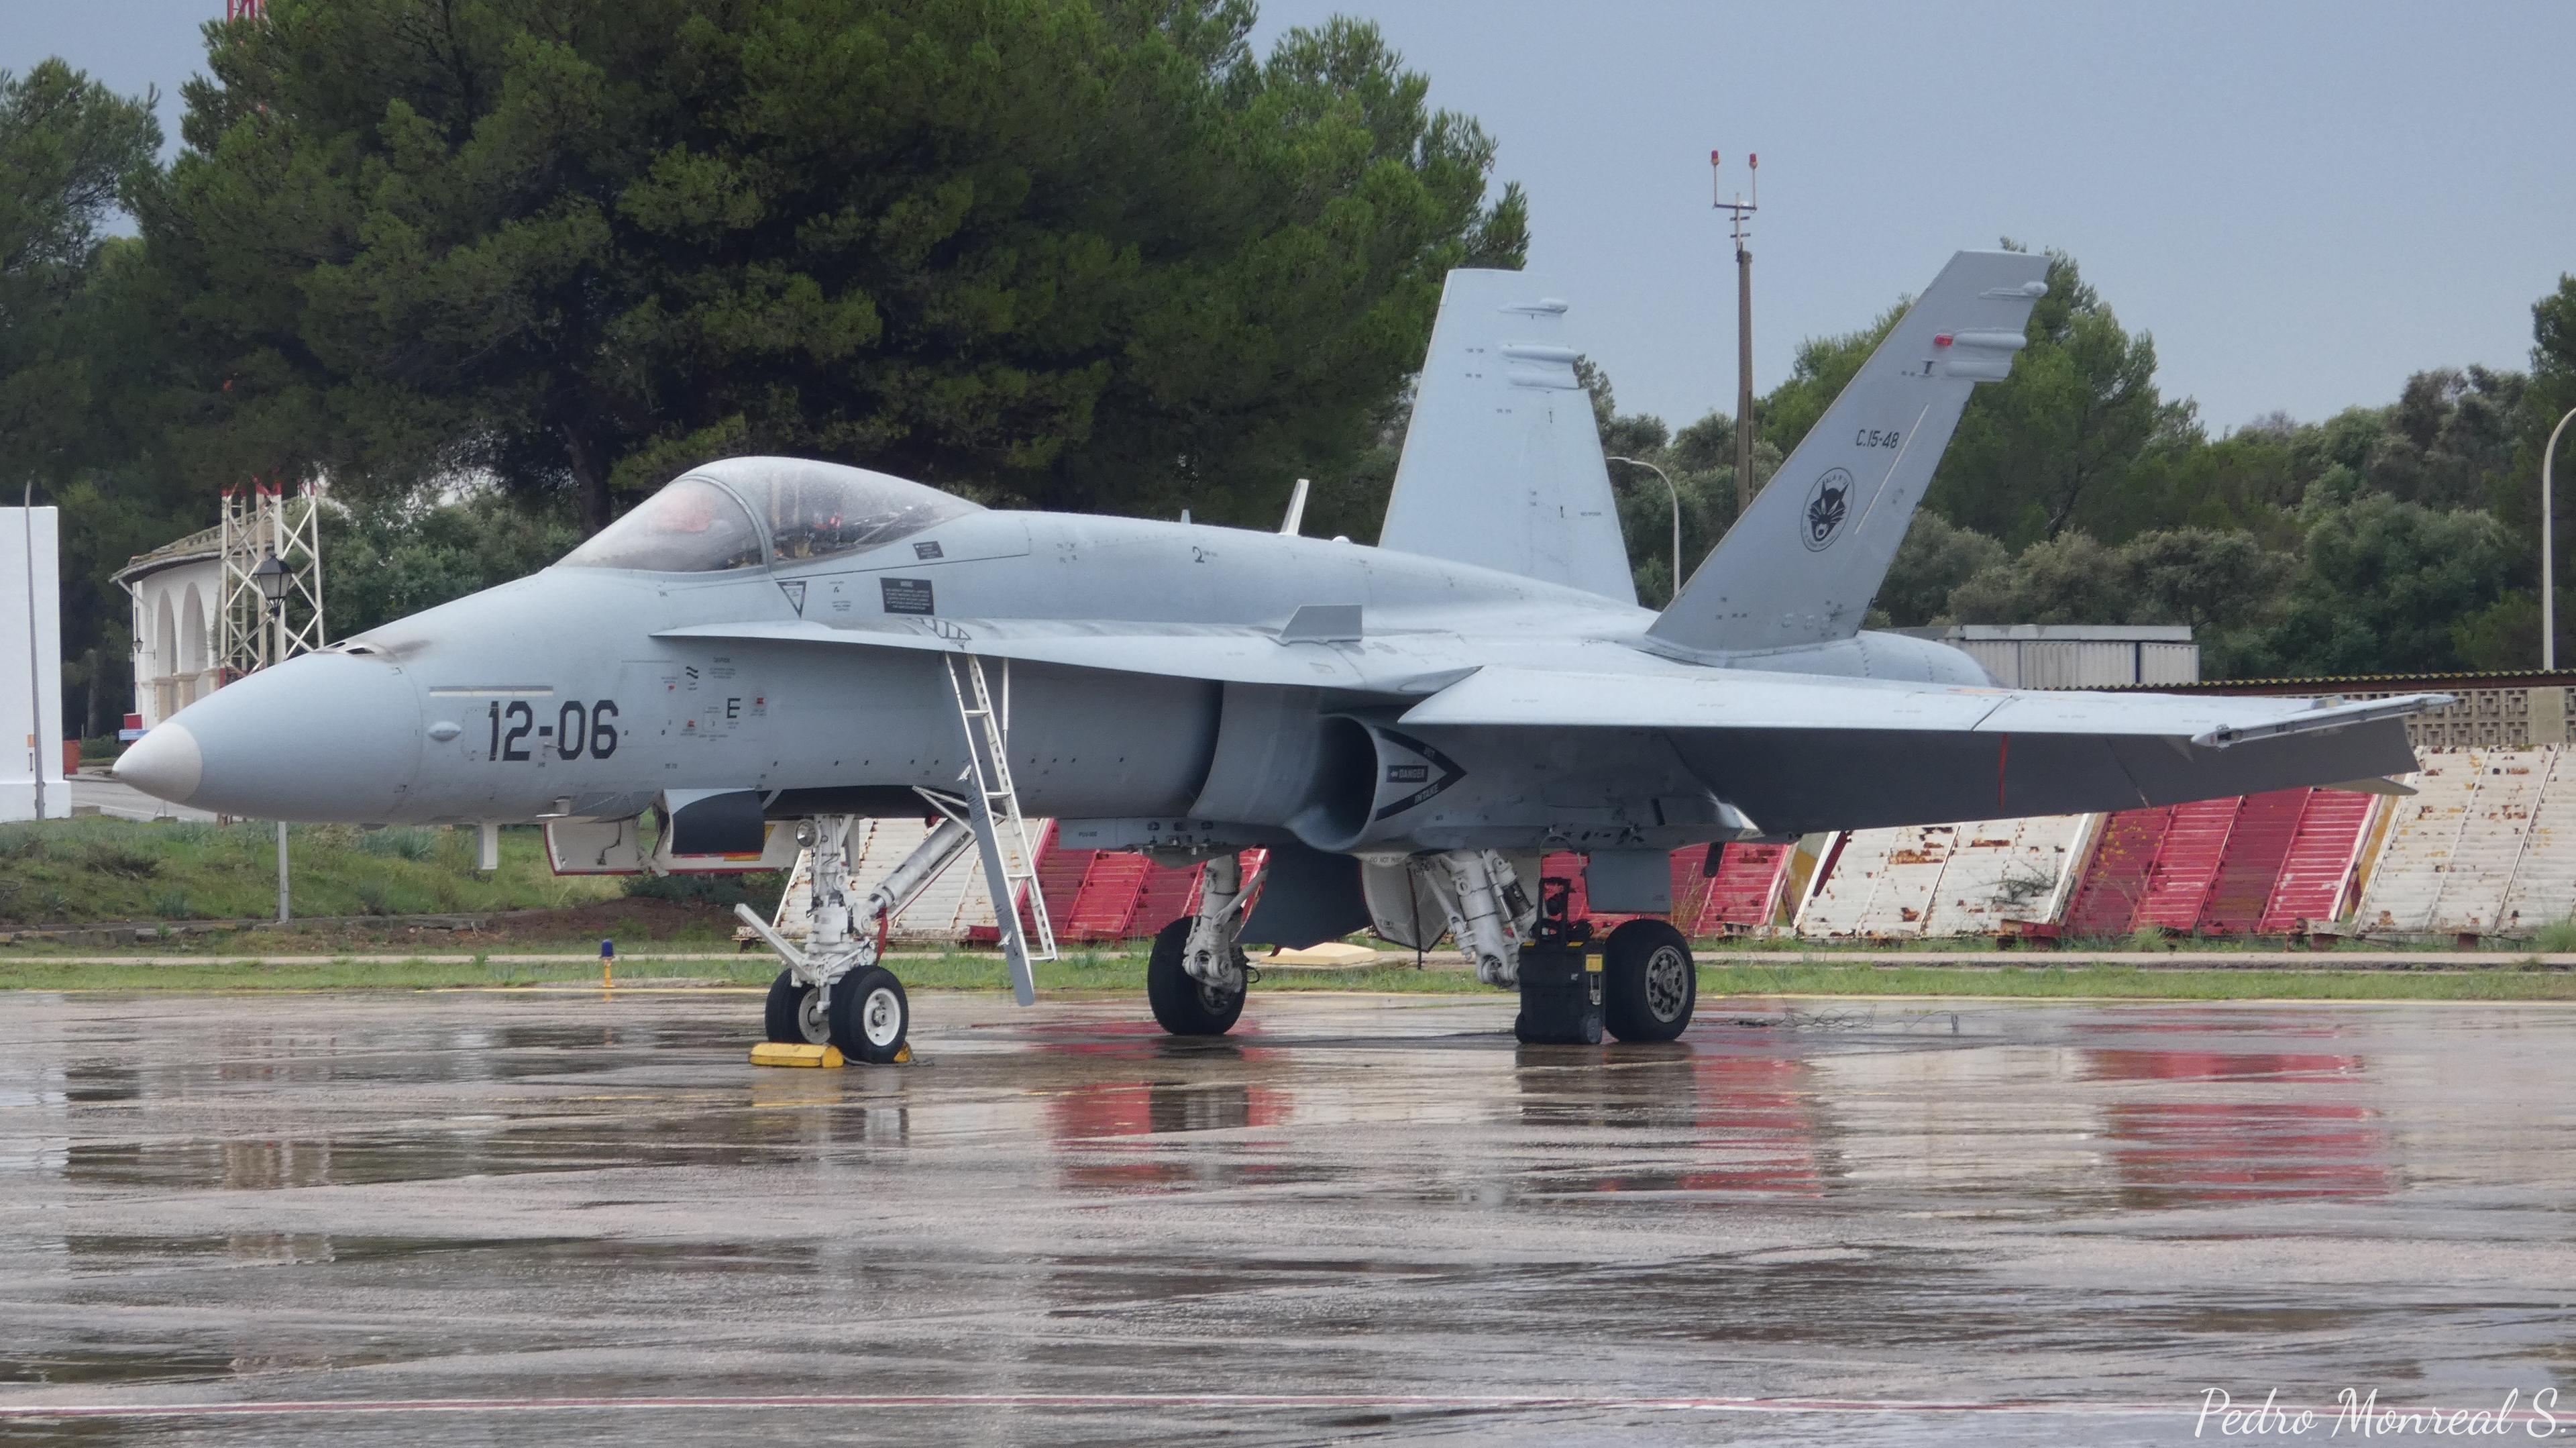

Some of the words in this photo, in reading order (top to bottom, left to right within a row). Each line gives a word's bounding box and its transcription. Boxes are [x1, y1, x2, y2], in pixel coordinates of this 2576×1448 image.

[1192, 546, 1205, 563] 2
[727, 698, 741, 719] E
[488, 700, 619, 762] 12-06
[1398, 768, 1425, 779] DANGER
[1414, 782, 1439, 805] INTAKE
